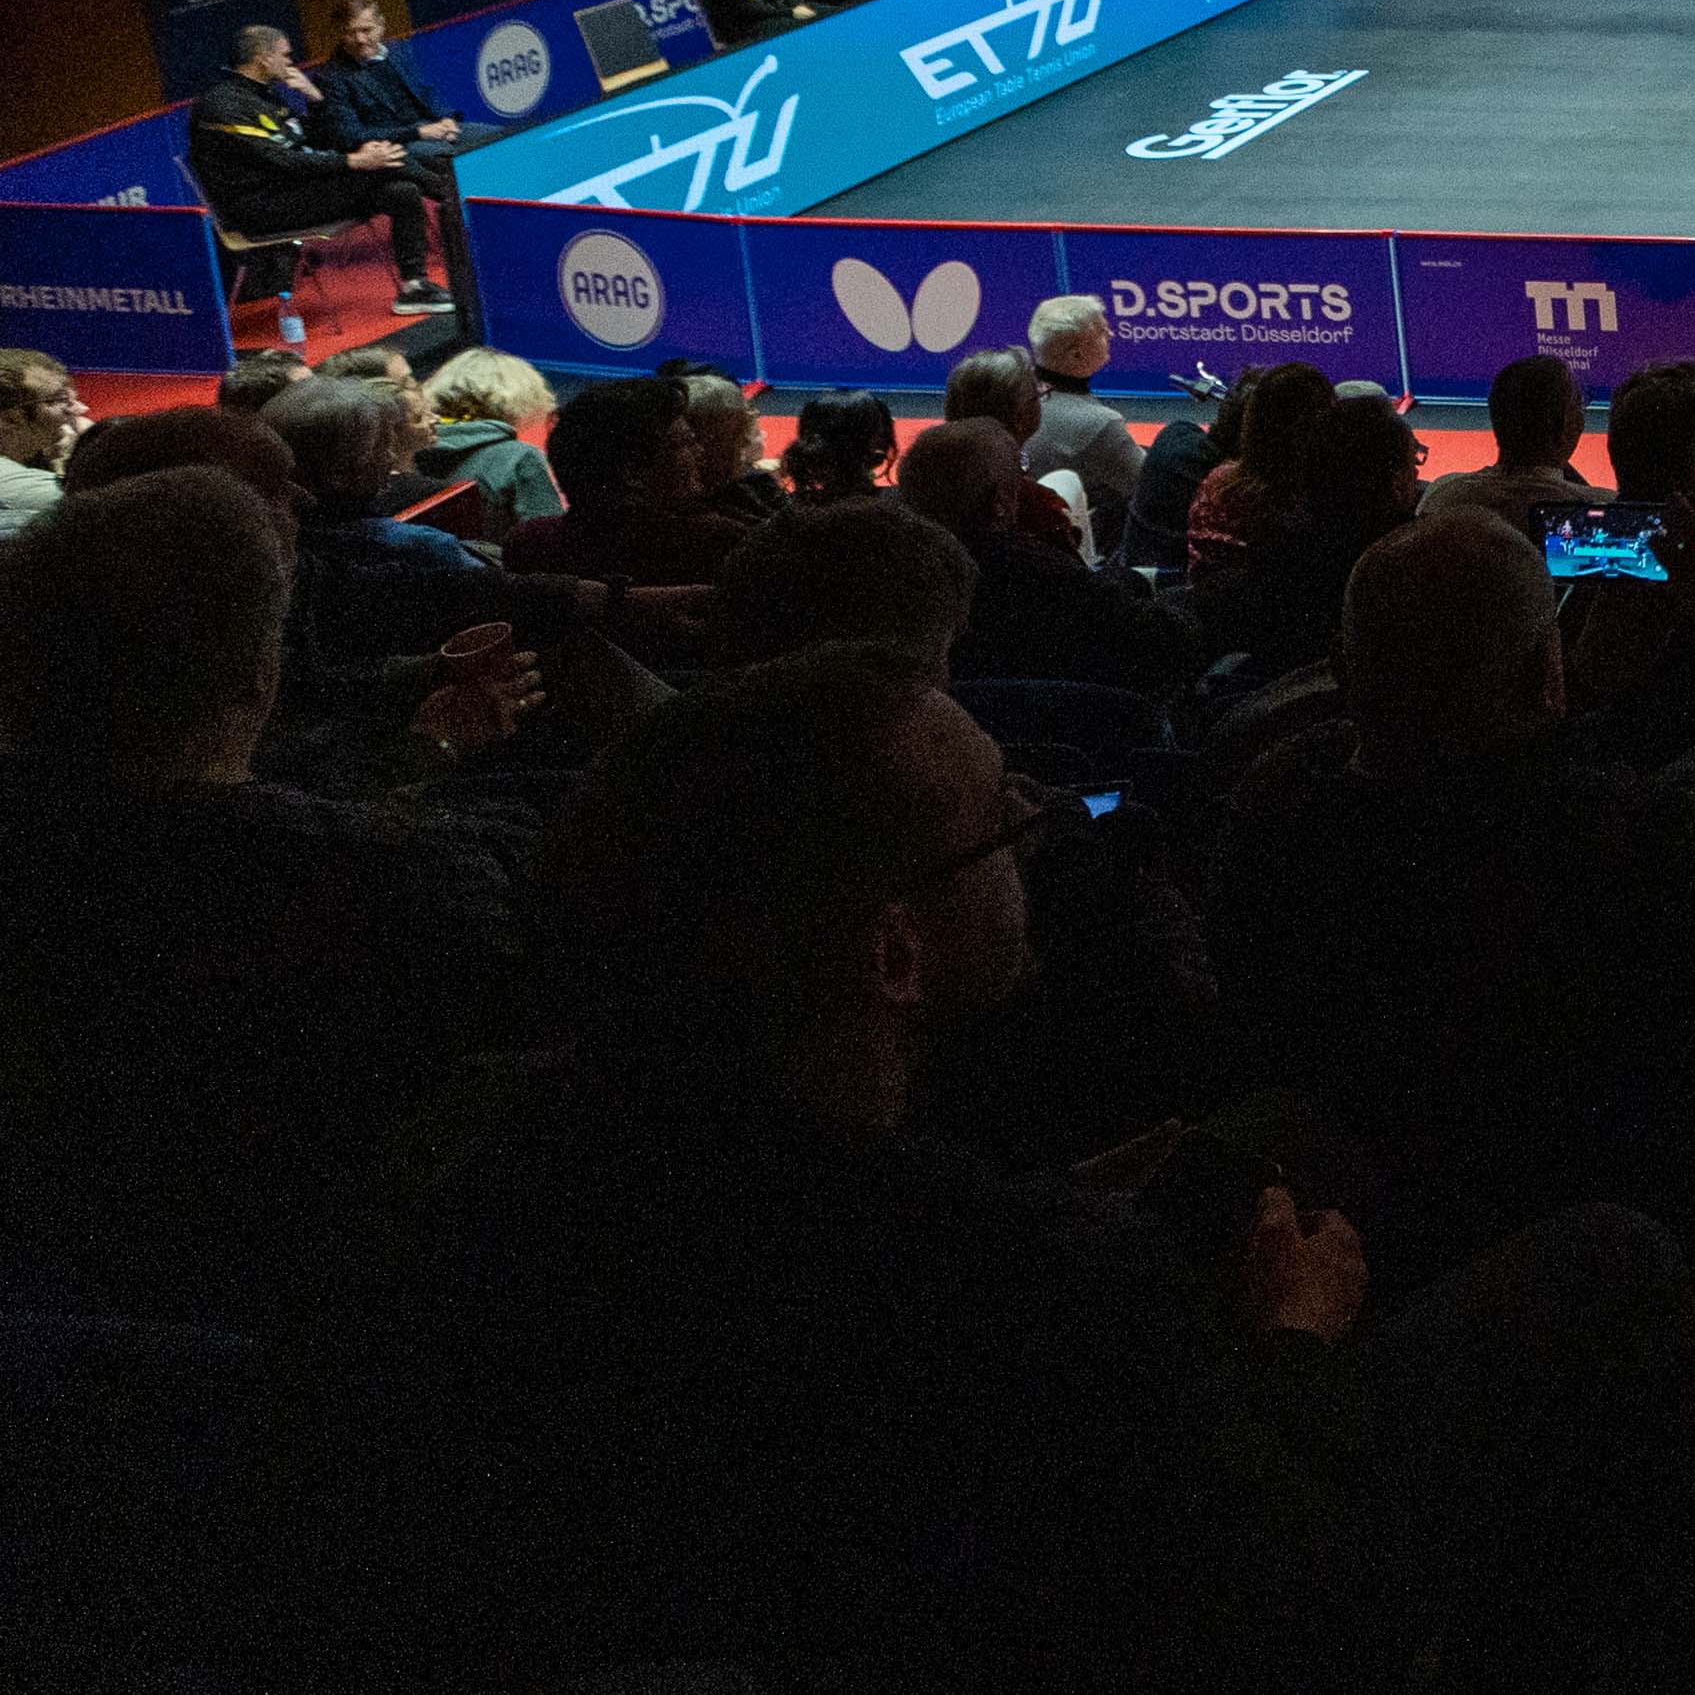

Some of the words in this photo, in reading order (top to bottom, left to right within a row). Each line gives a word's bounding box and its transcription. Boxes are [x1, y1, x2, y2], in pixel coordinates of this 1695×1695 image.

[485, 49, 542, 90] ARAG
[935, 89, 994, 125] European
[993, 74, 1026, 98] Table
[1125, 69, 1342, 160] Gerflor
[574, 271, 649, 309] ARAG
[1109, 279, 1353, 322] D.SPORTS
[1117, 322, 1237, 345] Sportstadt
[1241, 323, 1354, 345] Düsseldorf
[1537, 332, 1571, 346] Messe
[1538, 345, 1599, 358] Düsseldorf
